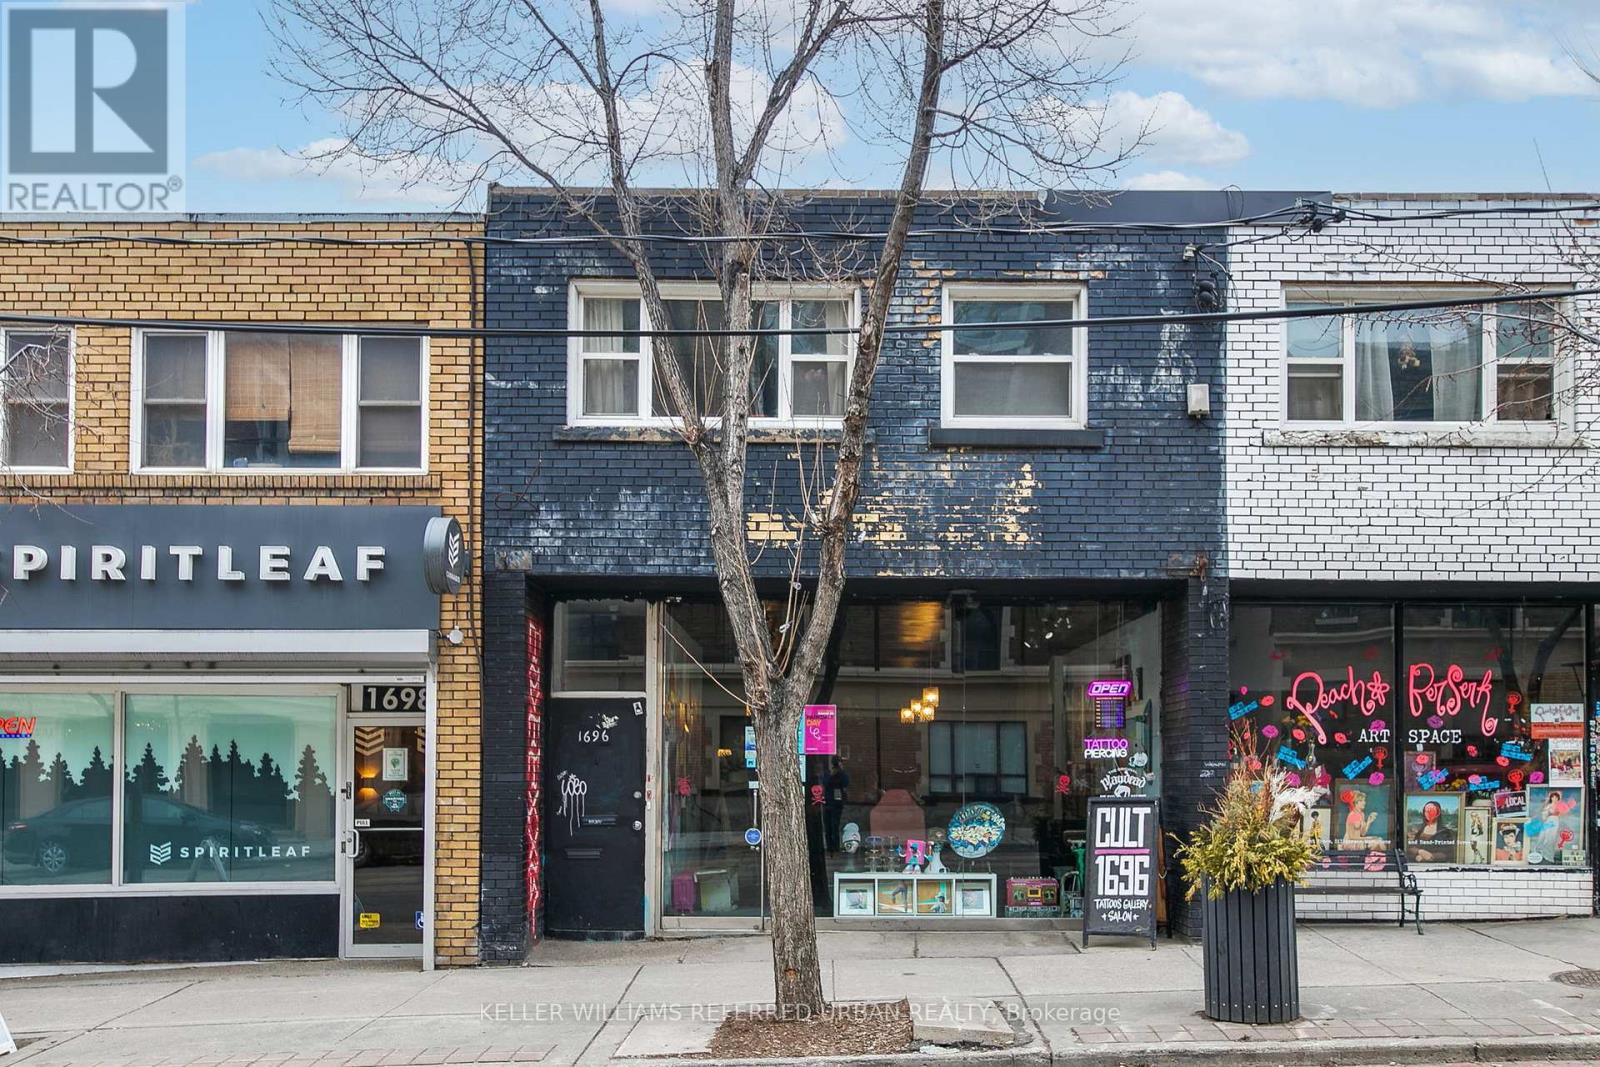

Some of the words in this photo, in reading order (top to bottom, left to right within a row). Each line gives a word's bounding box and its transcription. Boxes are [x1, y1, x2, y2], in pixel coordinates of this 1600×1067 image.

[1091, 683, 1129, 694] OPEN
[1286, 665, 1376, 745] Peach
[578, 729, 610, 743] 1696
[1357, 729, 1391, 744] ART
[1408, 729, 1462, 744] SPACE
[1084, 738, 1129, 750] TATTOO
[1084, 749, 1128, 759] PIERCING
[1505, 795, 1527, 808] LOCAL
[1095, 806, 1152, 848] CULT
[179, 845, 311, 859] SPIRITLEAF
[1094, 855, 1151, 896] 1696
[1094, 898, 1122, 911] TATTOOS
